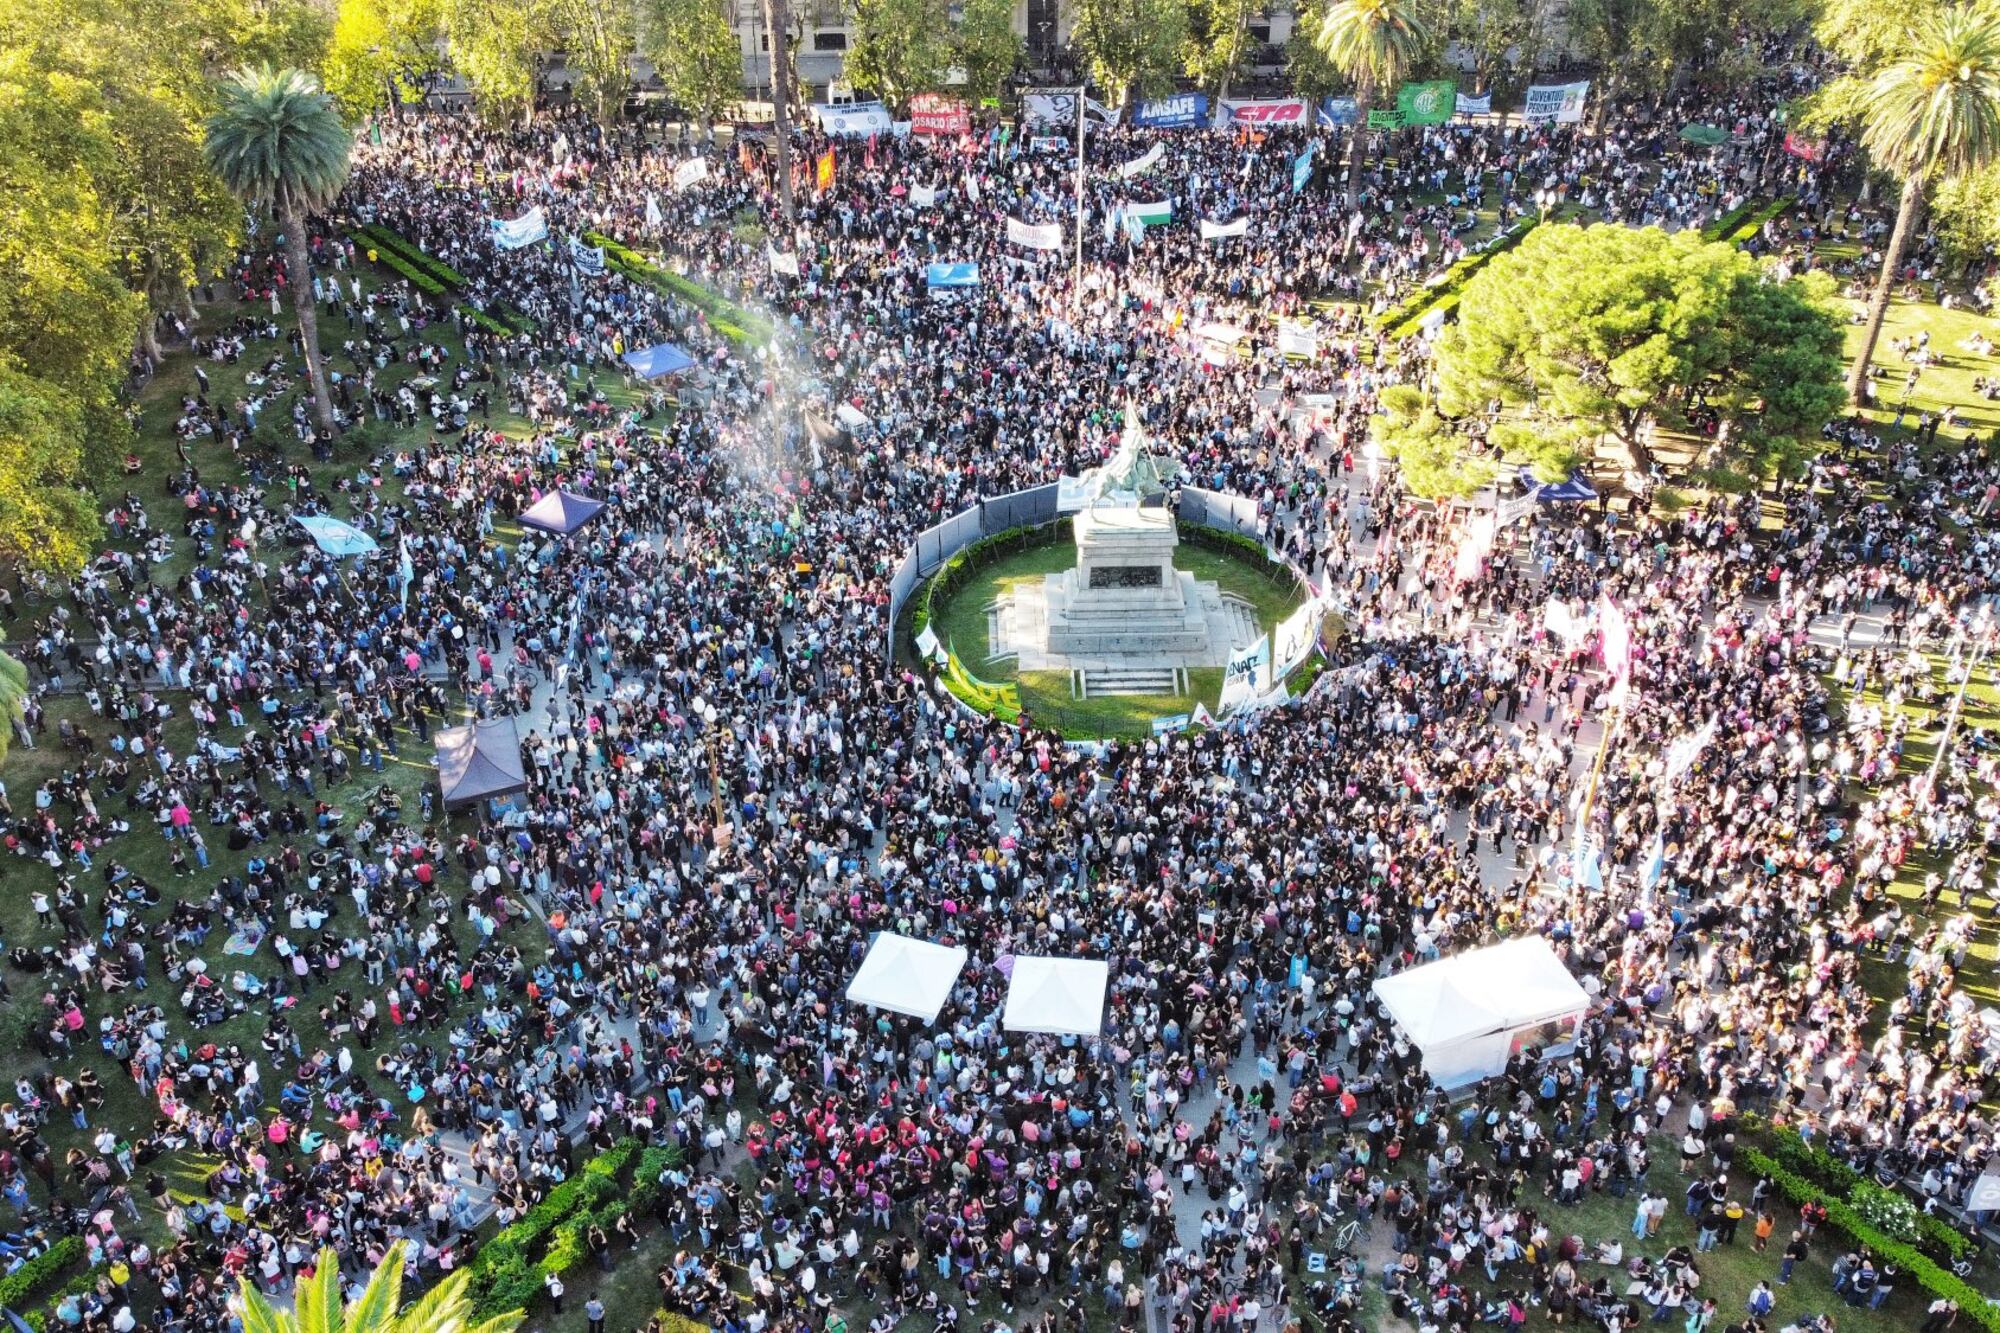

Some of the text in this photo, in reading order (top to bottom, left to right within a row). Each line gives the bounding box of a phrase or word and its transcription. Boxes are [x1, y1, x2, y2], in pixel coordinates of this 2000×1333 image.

[911, 96, 968, 113] AMSAFE
[1141, 97, 1195, 118] AMSAFE
[1233, 104, 1303, 121] CTA
